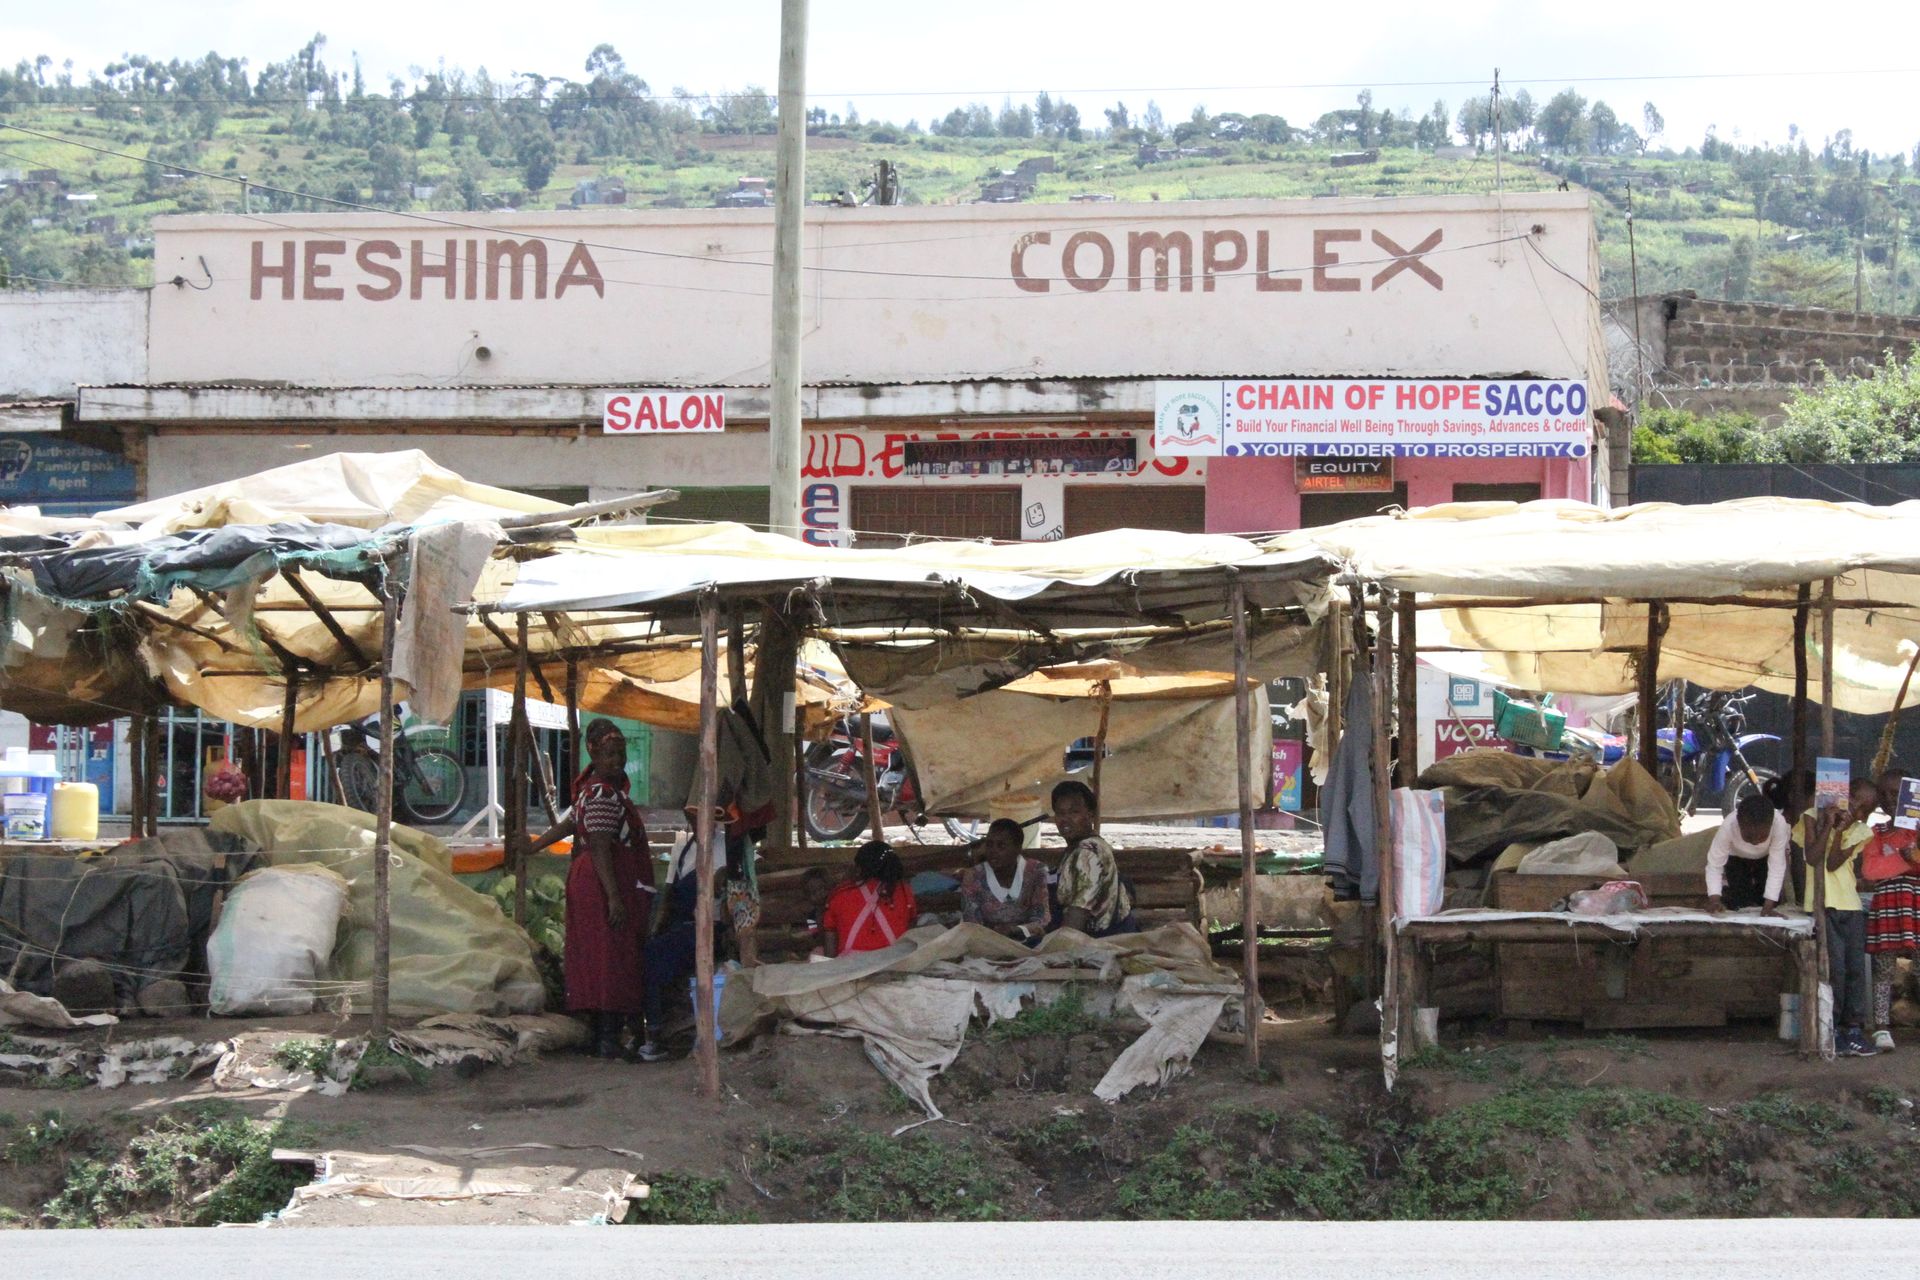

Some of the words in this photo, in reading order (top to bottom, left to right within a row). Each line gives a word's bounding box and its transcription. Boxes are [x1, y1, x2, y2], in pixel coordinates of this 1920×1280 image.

[250, 239, 604, 301] HESHIMA
[1011, 228, 1444, 293] COMPLEX
[1236, 384, 1334, 410] CHAIN
[1344, 384, 1385, 410] OF
[1396, 384, 1481, 410] HOPE
[1484, 383, 1587, 416] SACCO
[606, 395, 724, 431] SALON
[1236, 420, 1262, 433] Build
[1265, 420, 1288, 433] Your
[1291, 420, 1337, 433] Financial
[1340, 420, 1361, 433] Well
[1365, 420, 1394, 436] Being
[1397, 420, 1439, 436] Through
[1443, 420, 1486, 436] Savings,
[1489, 420, 1539, 433] Advances
[1543, 419, 1551, 432] &
[1554, 419, 1586, 432] Credit
[1251, 443, 1308, 457] YOUR
[1313, 443, 1396, 457] LADDER
[1401, 443, 1428, 457] TO
[1434, 443, 1563, 457] PROSPERITY
[37, 461, 80, 474] Family
[81, 460, 114, 472] Bank
[1310, 462, 1382, 474] EQUITY
[48, 476, 87, 491] Agent
[1303, 476, 1345, 488] AIRTEL
[1346, 474, 1385, 488] MONEY
[47, 731, 97, 744] AET
